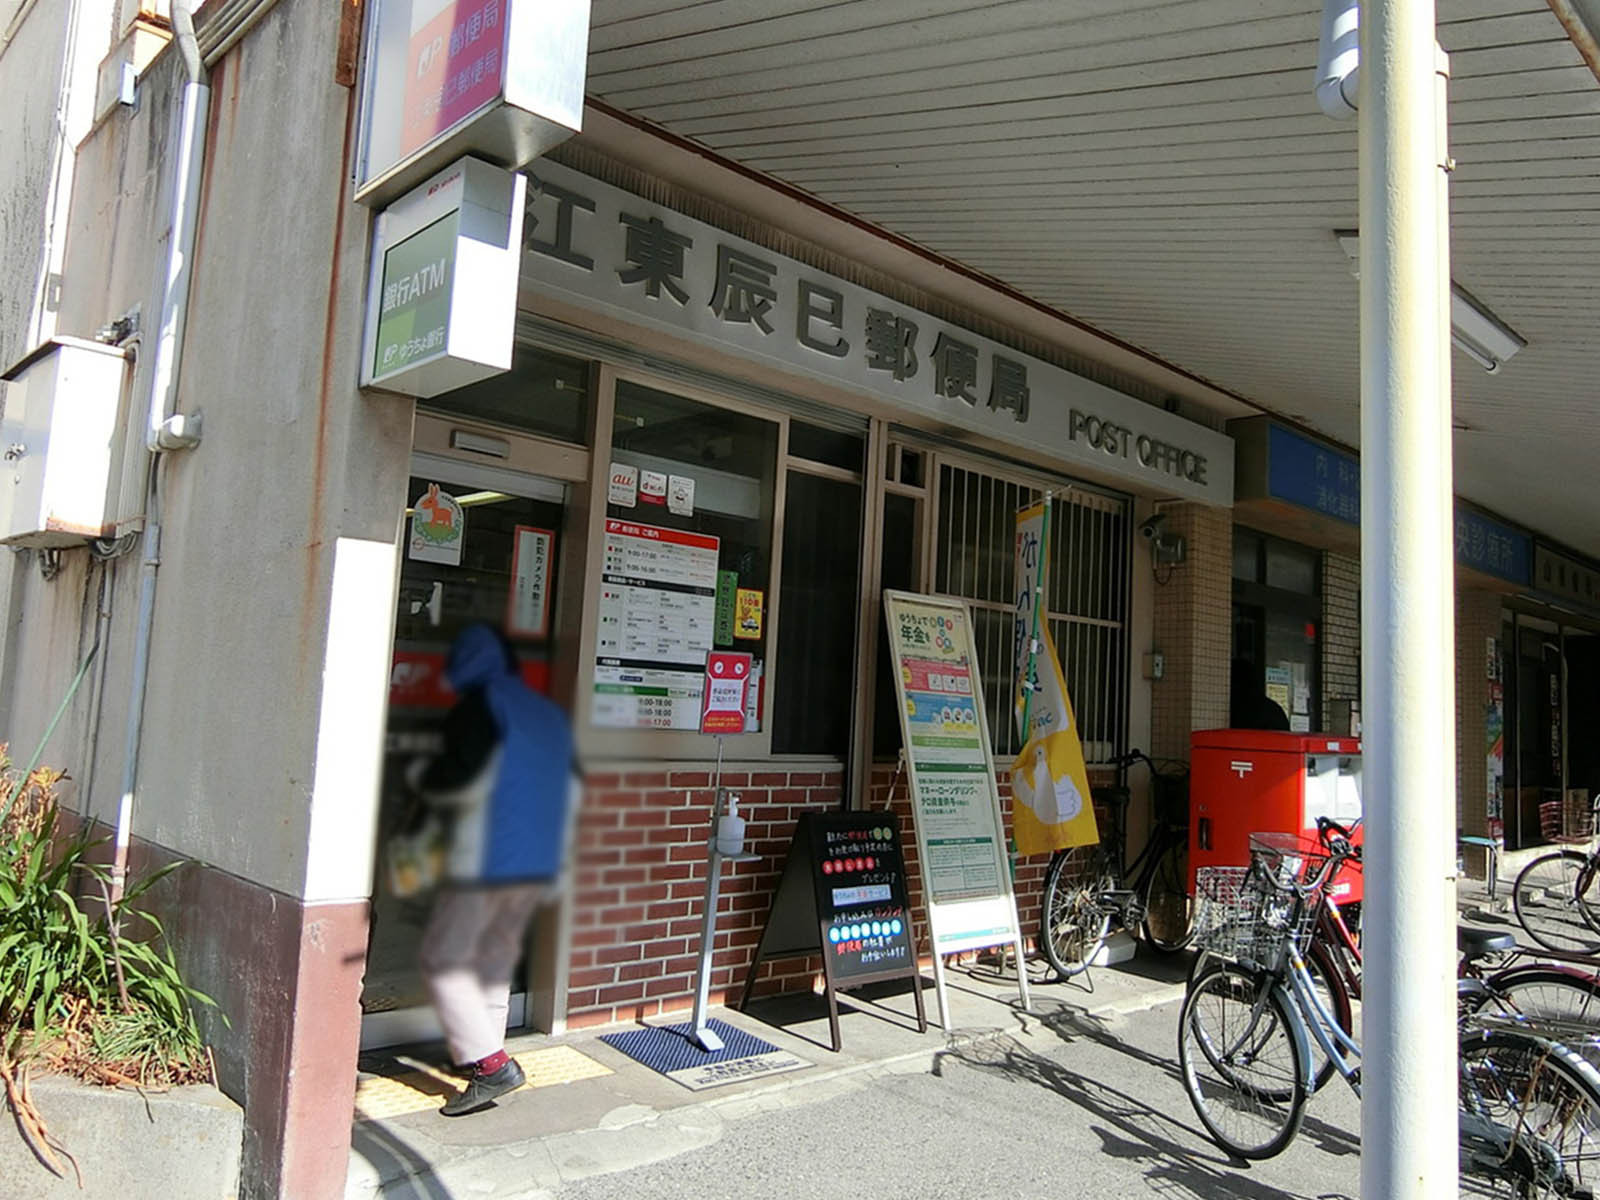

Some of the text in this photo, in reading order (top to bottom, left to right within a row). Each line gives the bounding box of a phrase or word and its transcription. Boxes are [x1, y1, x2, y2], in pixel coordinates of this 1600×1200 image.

[449, 1, 498, 58] 郵便局
[382, 258, 446, 312] 銀行ATM
[525, 171, 1030, 424] 江東辰巳郵便局
[400, 326, 445, 360] ゆうちょ銀行
[1069, 408, 1208, 486] POST OFFICE
[612, 473, 634, 486] au
